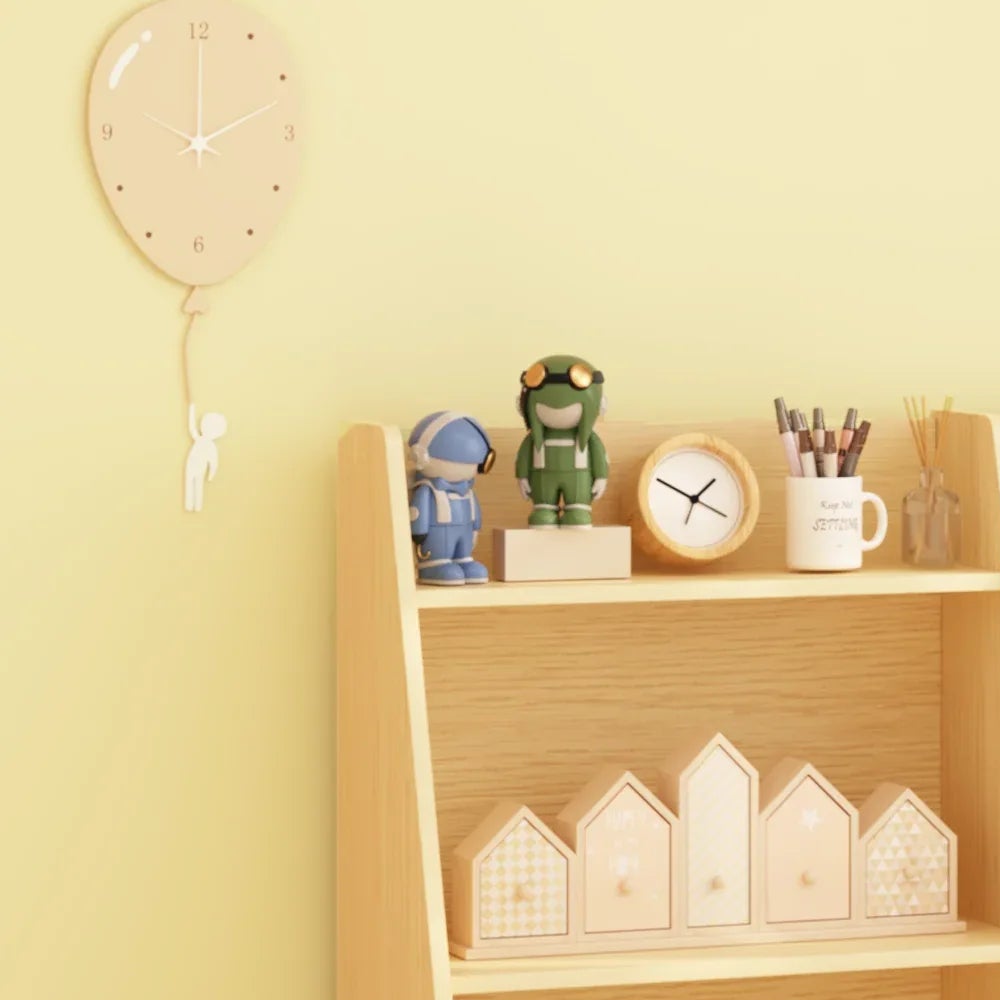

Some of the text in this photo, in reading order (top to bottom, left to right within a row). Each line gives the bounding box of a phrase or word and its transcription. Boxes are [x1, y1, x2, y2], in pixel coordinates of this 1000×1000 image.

[188, 21, 209, 40] 12
[101, 123, 113, 141] 9
[284, 125, 295, 142] 3
[193, 236, 204, 253] 6
